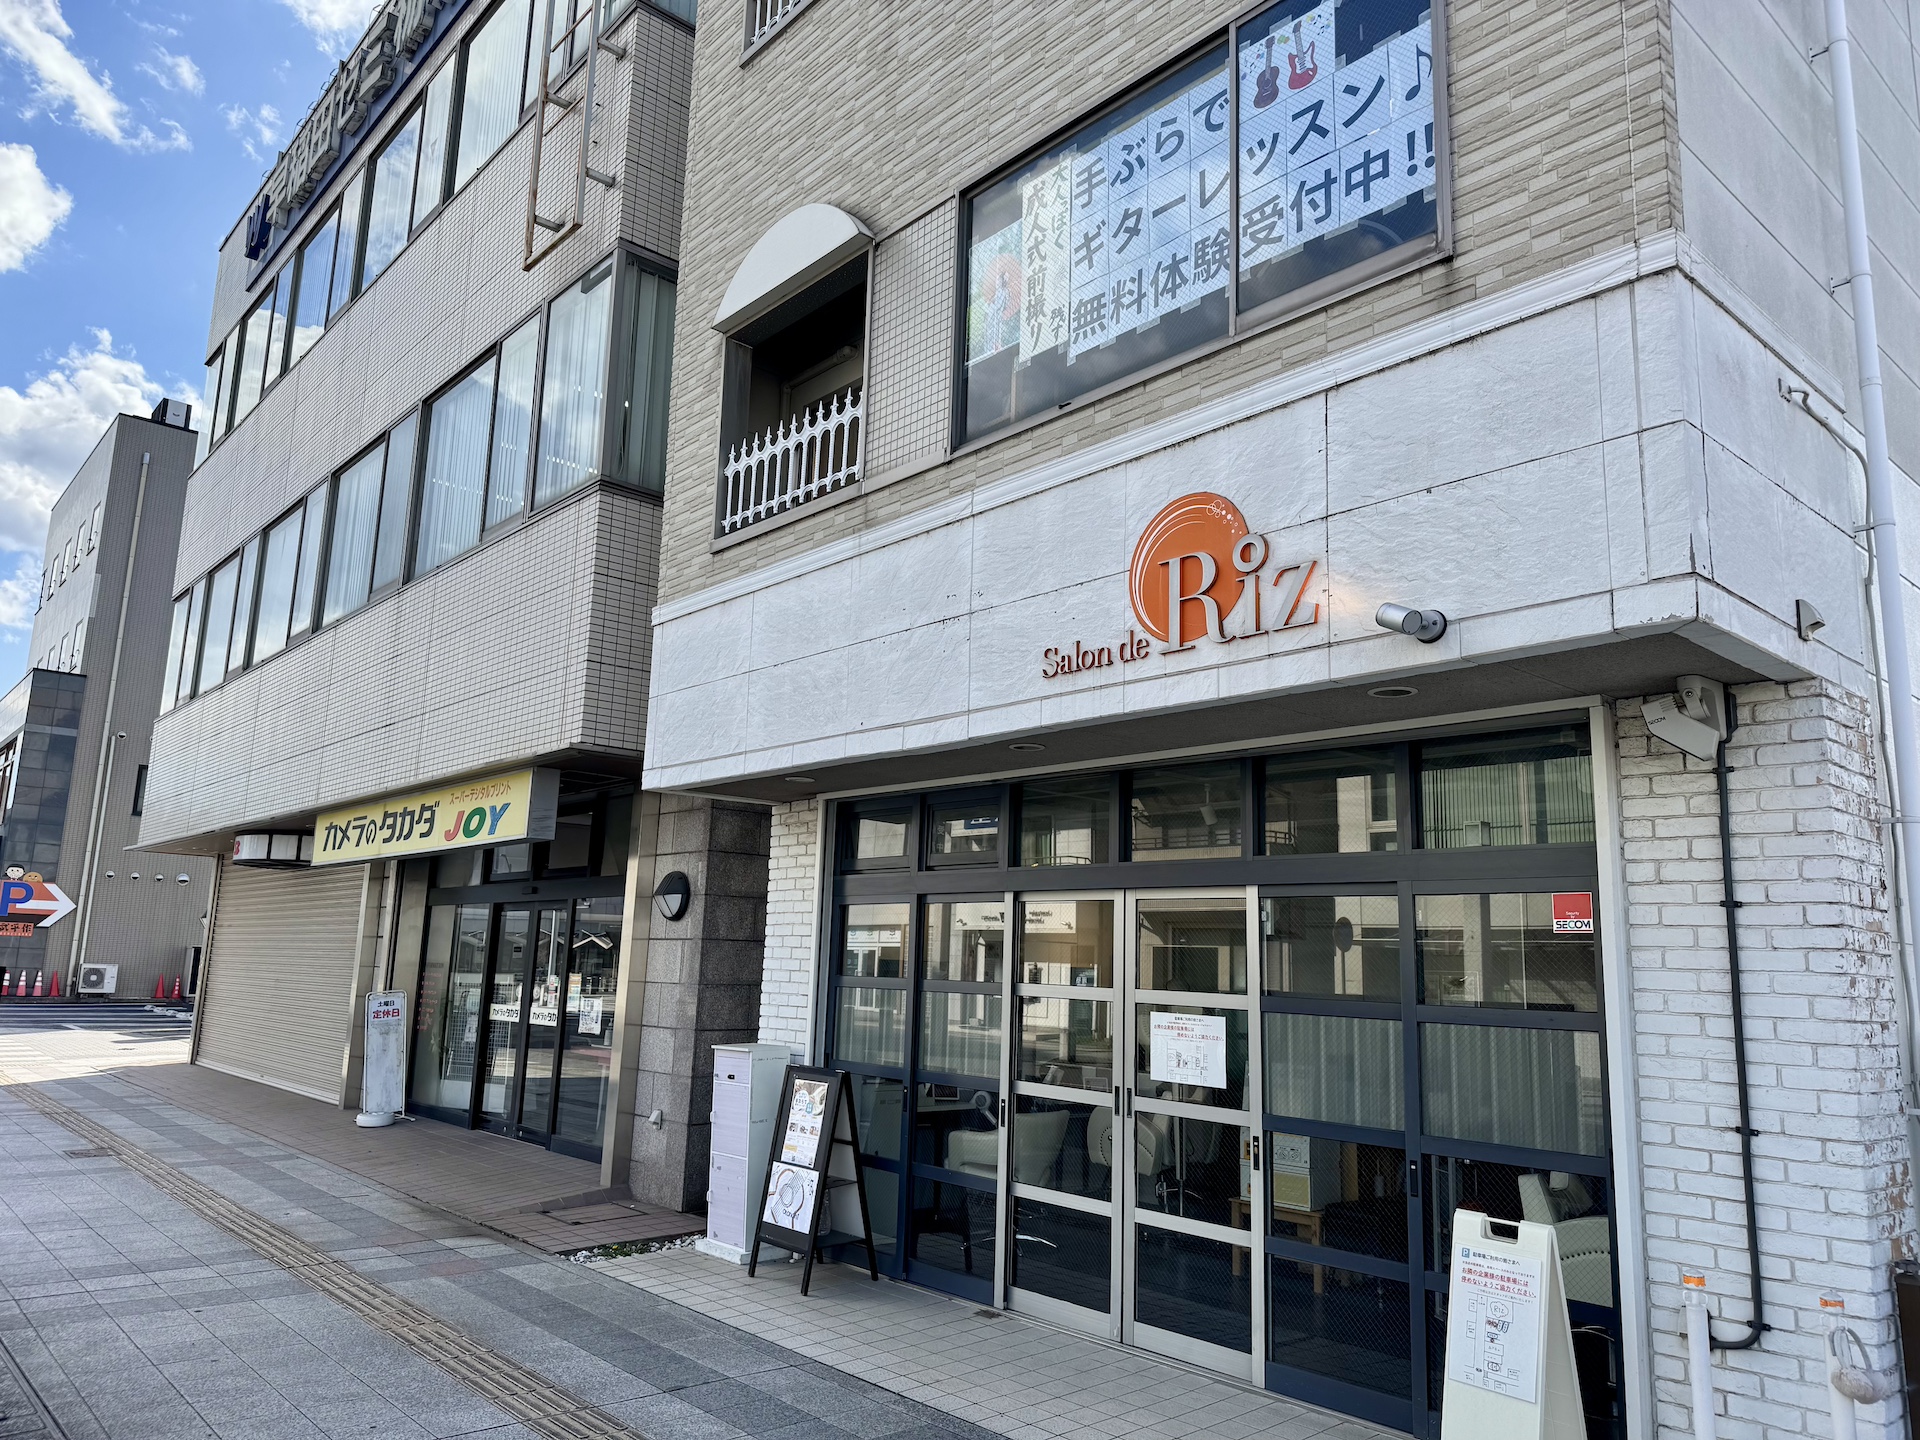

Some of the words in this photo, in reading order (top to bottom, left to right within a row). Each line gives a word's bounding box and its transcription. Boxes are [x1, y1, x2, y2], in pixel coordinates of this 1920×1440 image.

[1074, 88, 1230, 210] 手ぶらで
[1023, 180, 1049, 353] 成人式前撮り
[1157, 533, 1320, 655] Riz
[1042, 640, 1113, 679] Salon
[1117, 630, 1150, 663] de
[449, 780, 512, 805] スーパーデジタルプリント
[322, 800, 441, 852] カメラのタカダ
[444, 802, 512, 842] JOY
[0, 881, 34, 917] P
[1555, 920, 1591, 929] SECOM
[372, 1008, 401, 1020] 定休日
[377, 1000, 395, 1008] 土曜日
[531, 1011, 558, 1023] カメラのタカ
